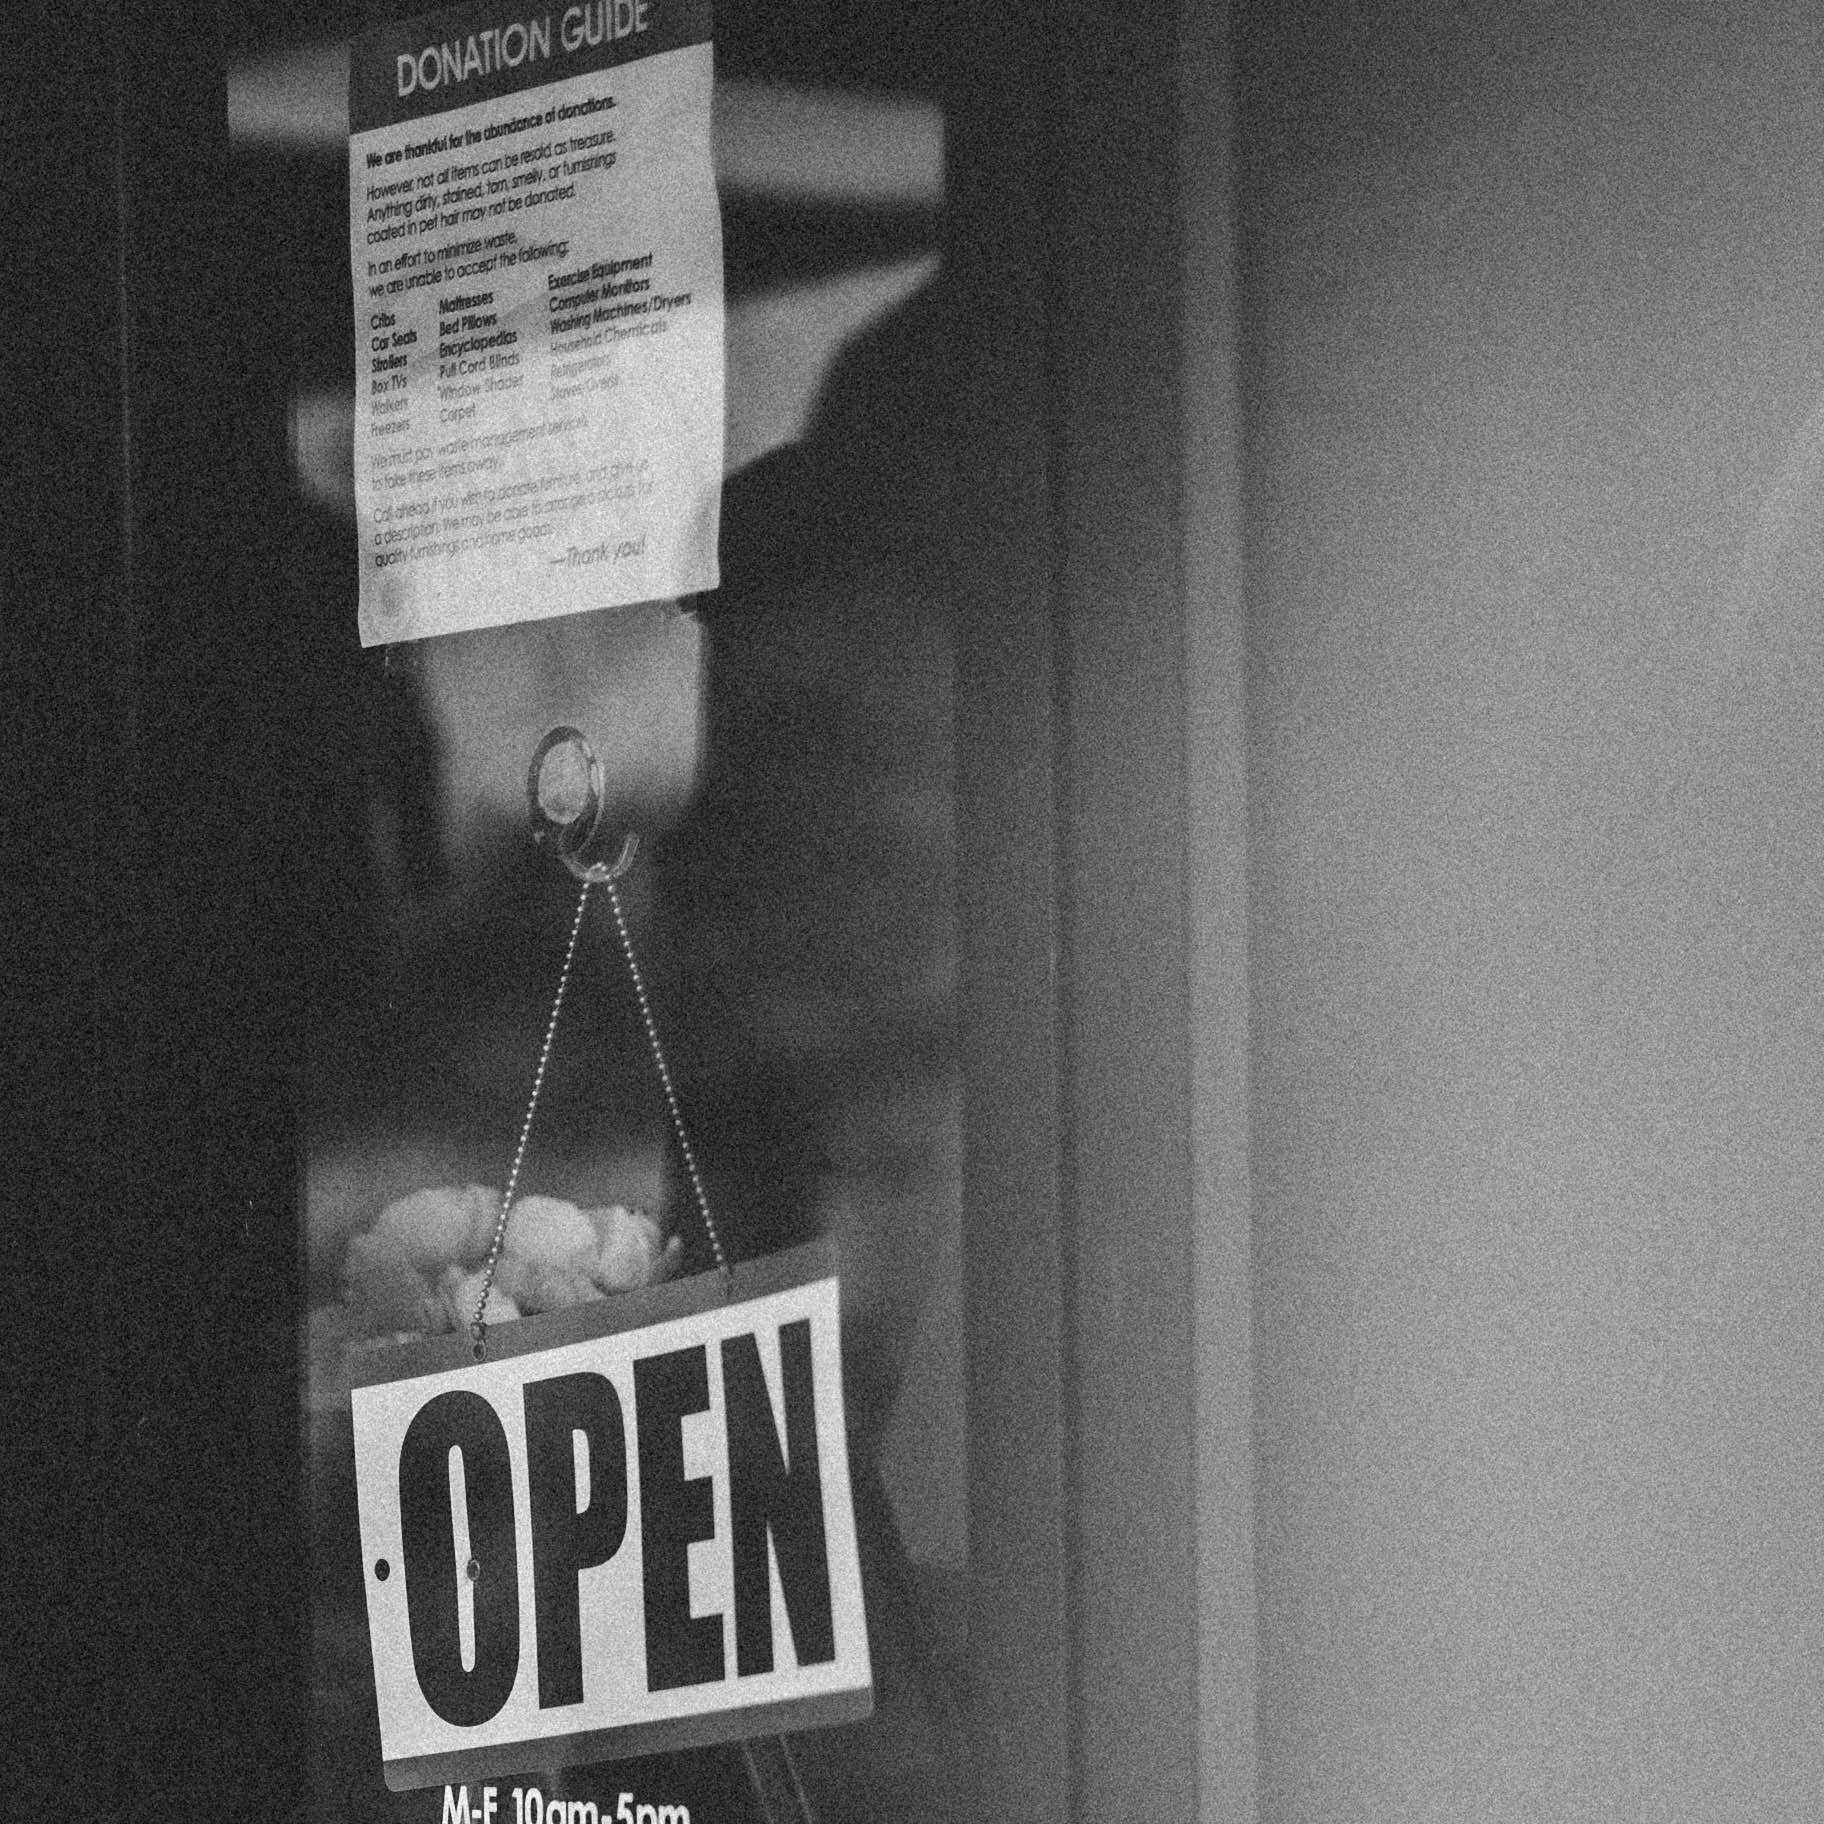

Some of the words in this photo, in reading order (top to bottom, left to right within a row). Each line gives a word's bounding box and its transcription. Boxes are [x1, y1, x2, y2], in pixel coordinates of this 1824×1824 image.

[397, 17, 551, 98] DONATION
[366, 153, 382, 168] We
[384, 150, 402, 164] are
[404, 136, 447, 159] thankful
[448, 133, 463, 149] for
[465, 130, 481, 145] the
[483, 114, 543, 140] abundance
[544, 106, 555, 124] of
[416, 172, 434, 187] not
[436, 167, 449, 184] all
[450, 163, 479, 180] items
[480, 157, 502, 174] can
[504, 154, 519, 168] be
[519, 142, 551, 163] resold
[553, 141, 567, 155] as
[366, 200, 412, 222] Anything
[548, 164, 560, 179] or
[562, 151, 616, 175] furnishings
[366, 223, 405, 244] coated
[406, 219, 417, 235] in
[418, 214, 438, 234] pet
[440, 211, 459, 226] hair
[461, 206, 486, 221] may
[488, 198, 506, 216] not
[507, 197, 522, 211] be
[377, 259, 392, 274] an
[394, 251, 421, 270] effort
[422, 249, 436, 264] to
[436, 239, 482, 259] minimize
[591, 252, 652, 278] Equipment
[368, 284, 384, 296] we
[386, 279, 403, 294] are
[405, 269, 441, 289] unable
[443, 265, 455, 280] to
[456, 254, 497, 277] accept
[499, 252, 517, 265] the
[438, 291, 493, 314] Mattresses
[549, 289, 599, 312] Computer
[600, 278, 650, 299] Monitors
[370, 312, 395, 329] Cribs
[439, 319, 459, 336] Bed
[461, 313, 497, 329] Pillows
[549, 313, 591, 334] Washing
[592, 292, 692, 324] Machines/Dryers
[371, 336, 389, 351] Car
[391, 329, 417, 346] Seats
[438, 330, 517, 358] Encyclopedias
[603, 318, 667, 342] Chemicals
[371, 354, 407, 373] Strollers
[458, 356, 486, 375] Cord
[371, 379, 388, 395] Box
[391, 374, 407, 389] TVs
[399, 1317, 835, 1728] OPEN
